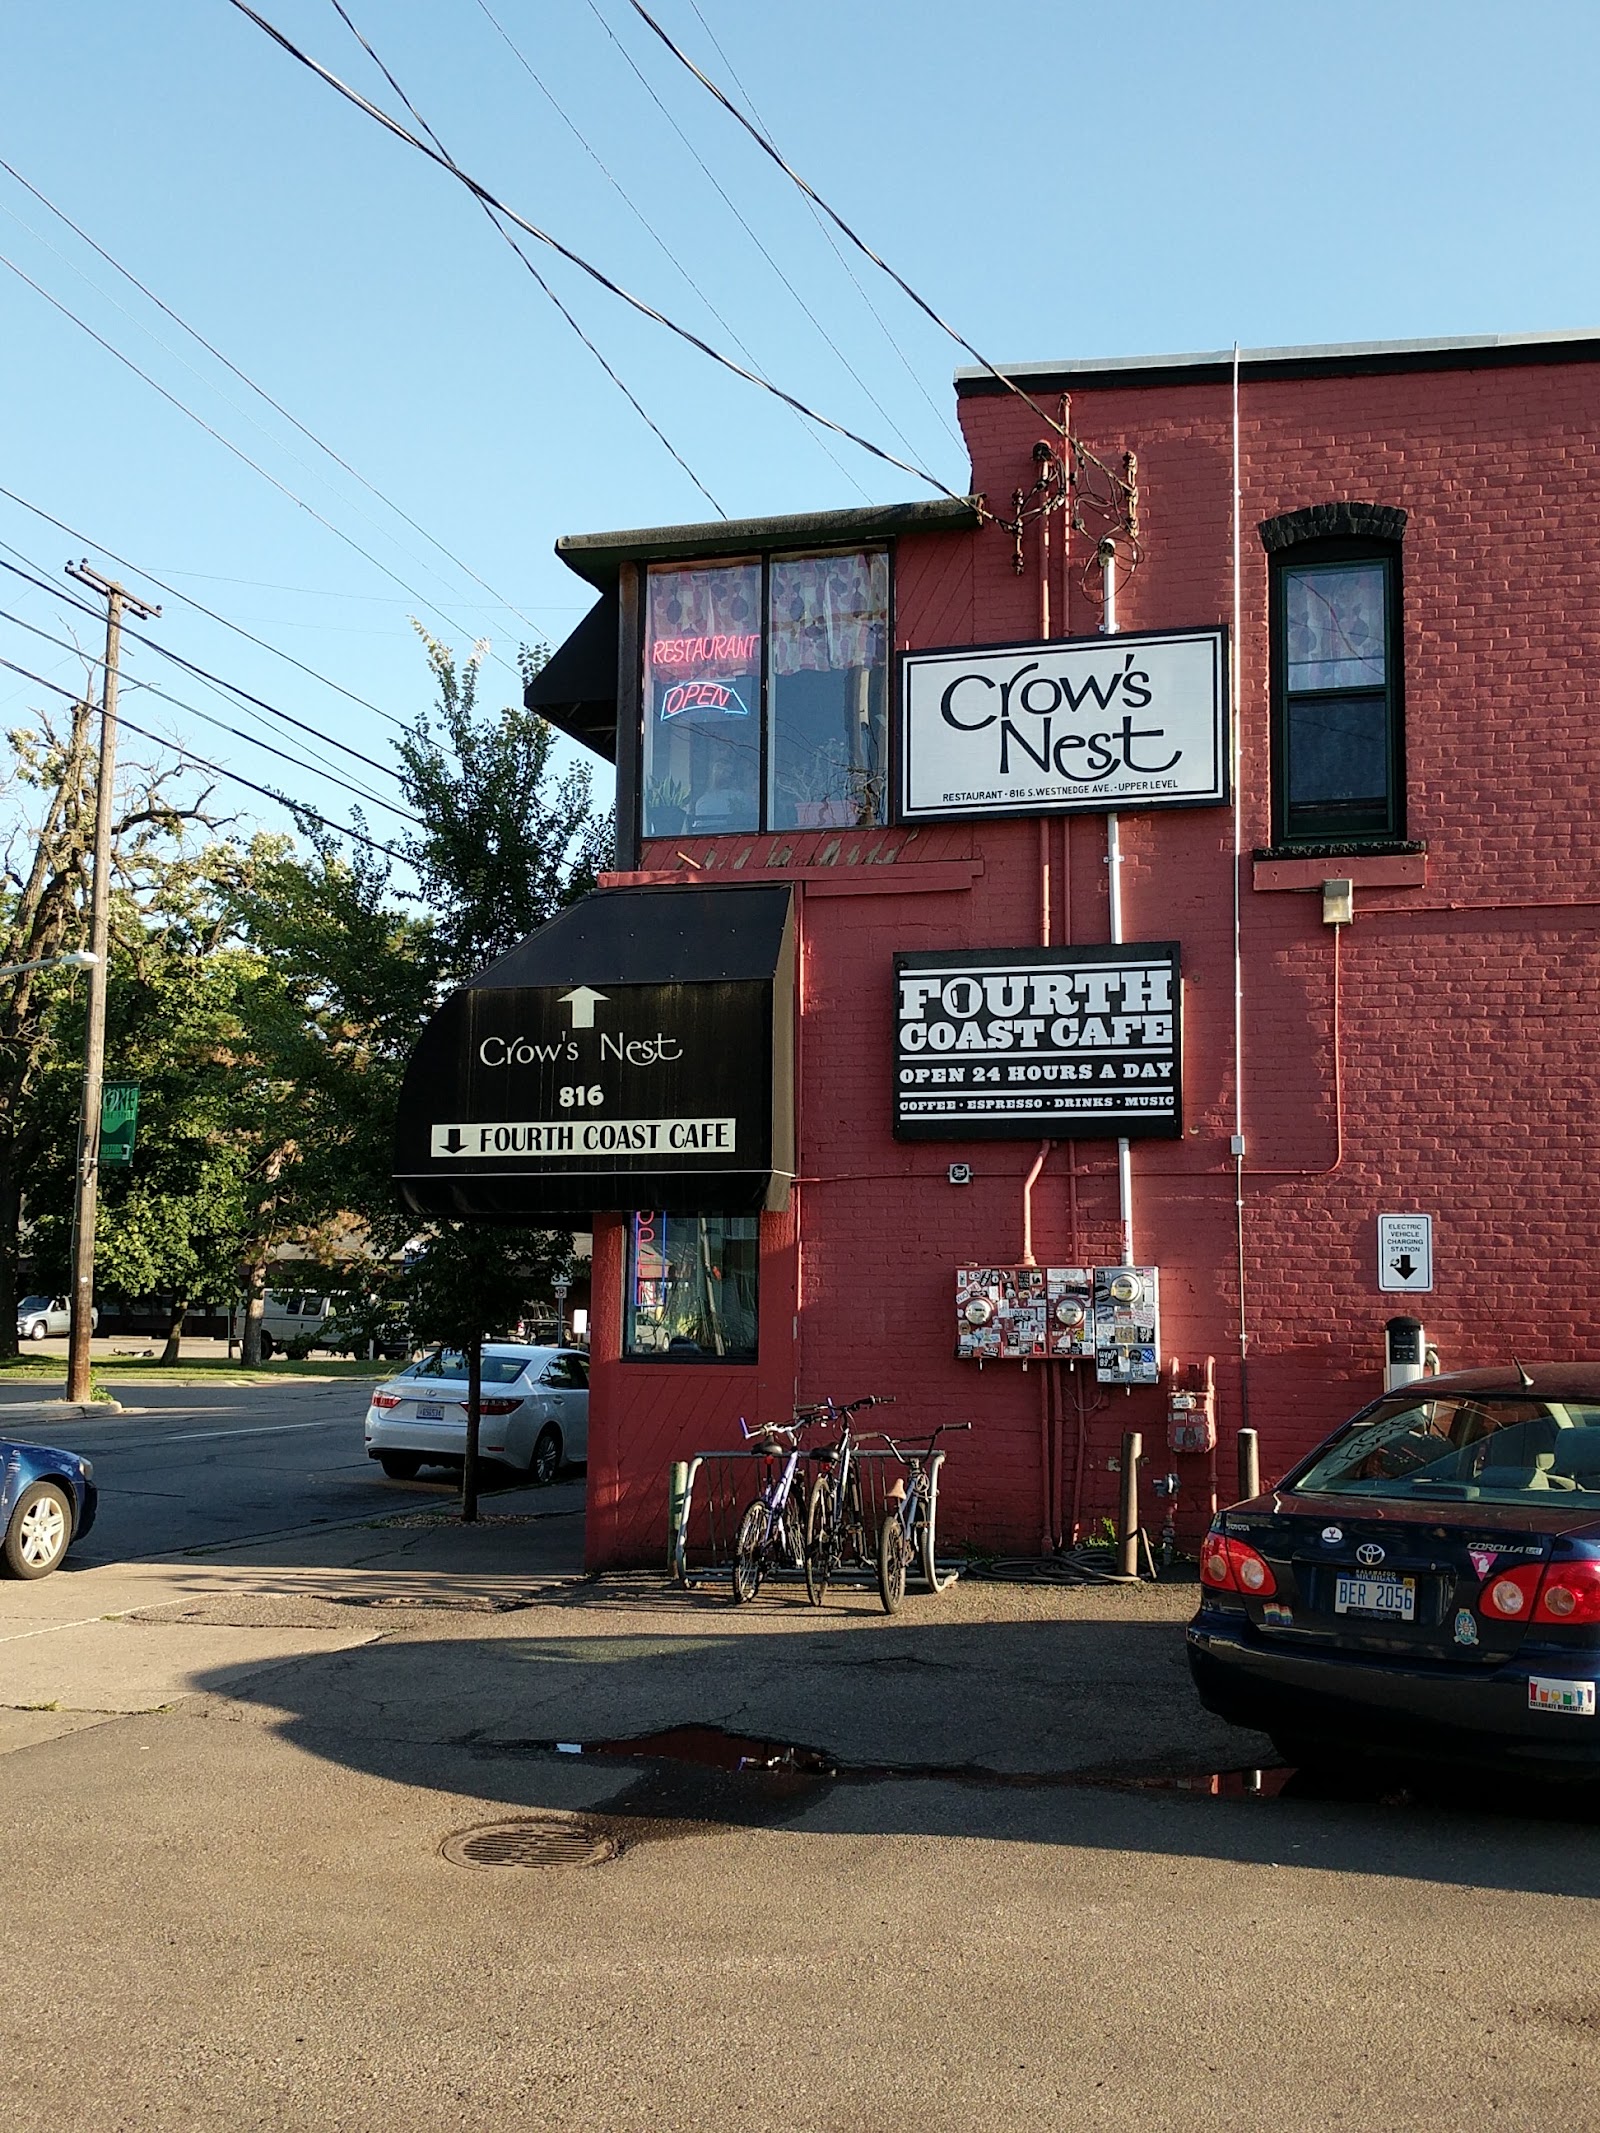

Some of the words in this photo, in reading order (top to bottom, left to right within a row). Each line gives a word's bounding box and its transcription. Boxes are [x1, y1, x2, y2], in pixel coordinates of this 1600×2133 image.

[653, 635, 760, 664] RESTAURANT
[667, 683, 730, 713] OPEN
[940, 653, 1152, 731] Crow's
[1000, 716, 1183, 782] Nest
[943, 790, 1003, 802] RESTAURANT
[1009, 788, 1025, 798] 816
[1150, 779, 1178, 790] LEVEL
[900, 970, 1173, 1019] FOURTH
[900, 1019, 1045, 1051] COAST
[1051, 1014, 1173, 1047] CAFE
[480, 1031, 579, 1066] Crow's
[600, 1032, 683, 1066] Nest
[900, 1068, 966, 1084] OPEN
[972, 1066, 1001, 1082] 24
[1008, 1064, 1093, 1081] HOURS
[1099, 1063, 1117, 1079] A
[1123, 1061, 1174, 1079] DAY
[559, 1084, 604, 1107] 816
[900, 1100, 956, 1111] COFFEE
[967, 1098, 1043, 1110] ESPRESSO
[1054, 1096, 1113, 1108] DRINKS
[1125, 1095, 1175, 1107] MUSIC
[480, 1126, 574, 1152] FOURTH
[583, 1124, 661, 1151] COAST
[669, 1122, 730, 1149] CAFE
[1467, 1542, 1524, 1553] COROLLA
[1356, 1574, 1397, 1583] MICHIGAN
[1339, 1582, 1366, 1606] BER
[1376, 1585, 1412, 1610] 2056
